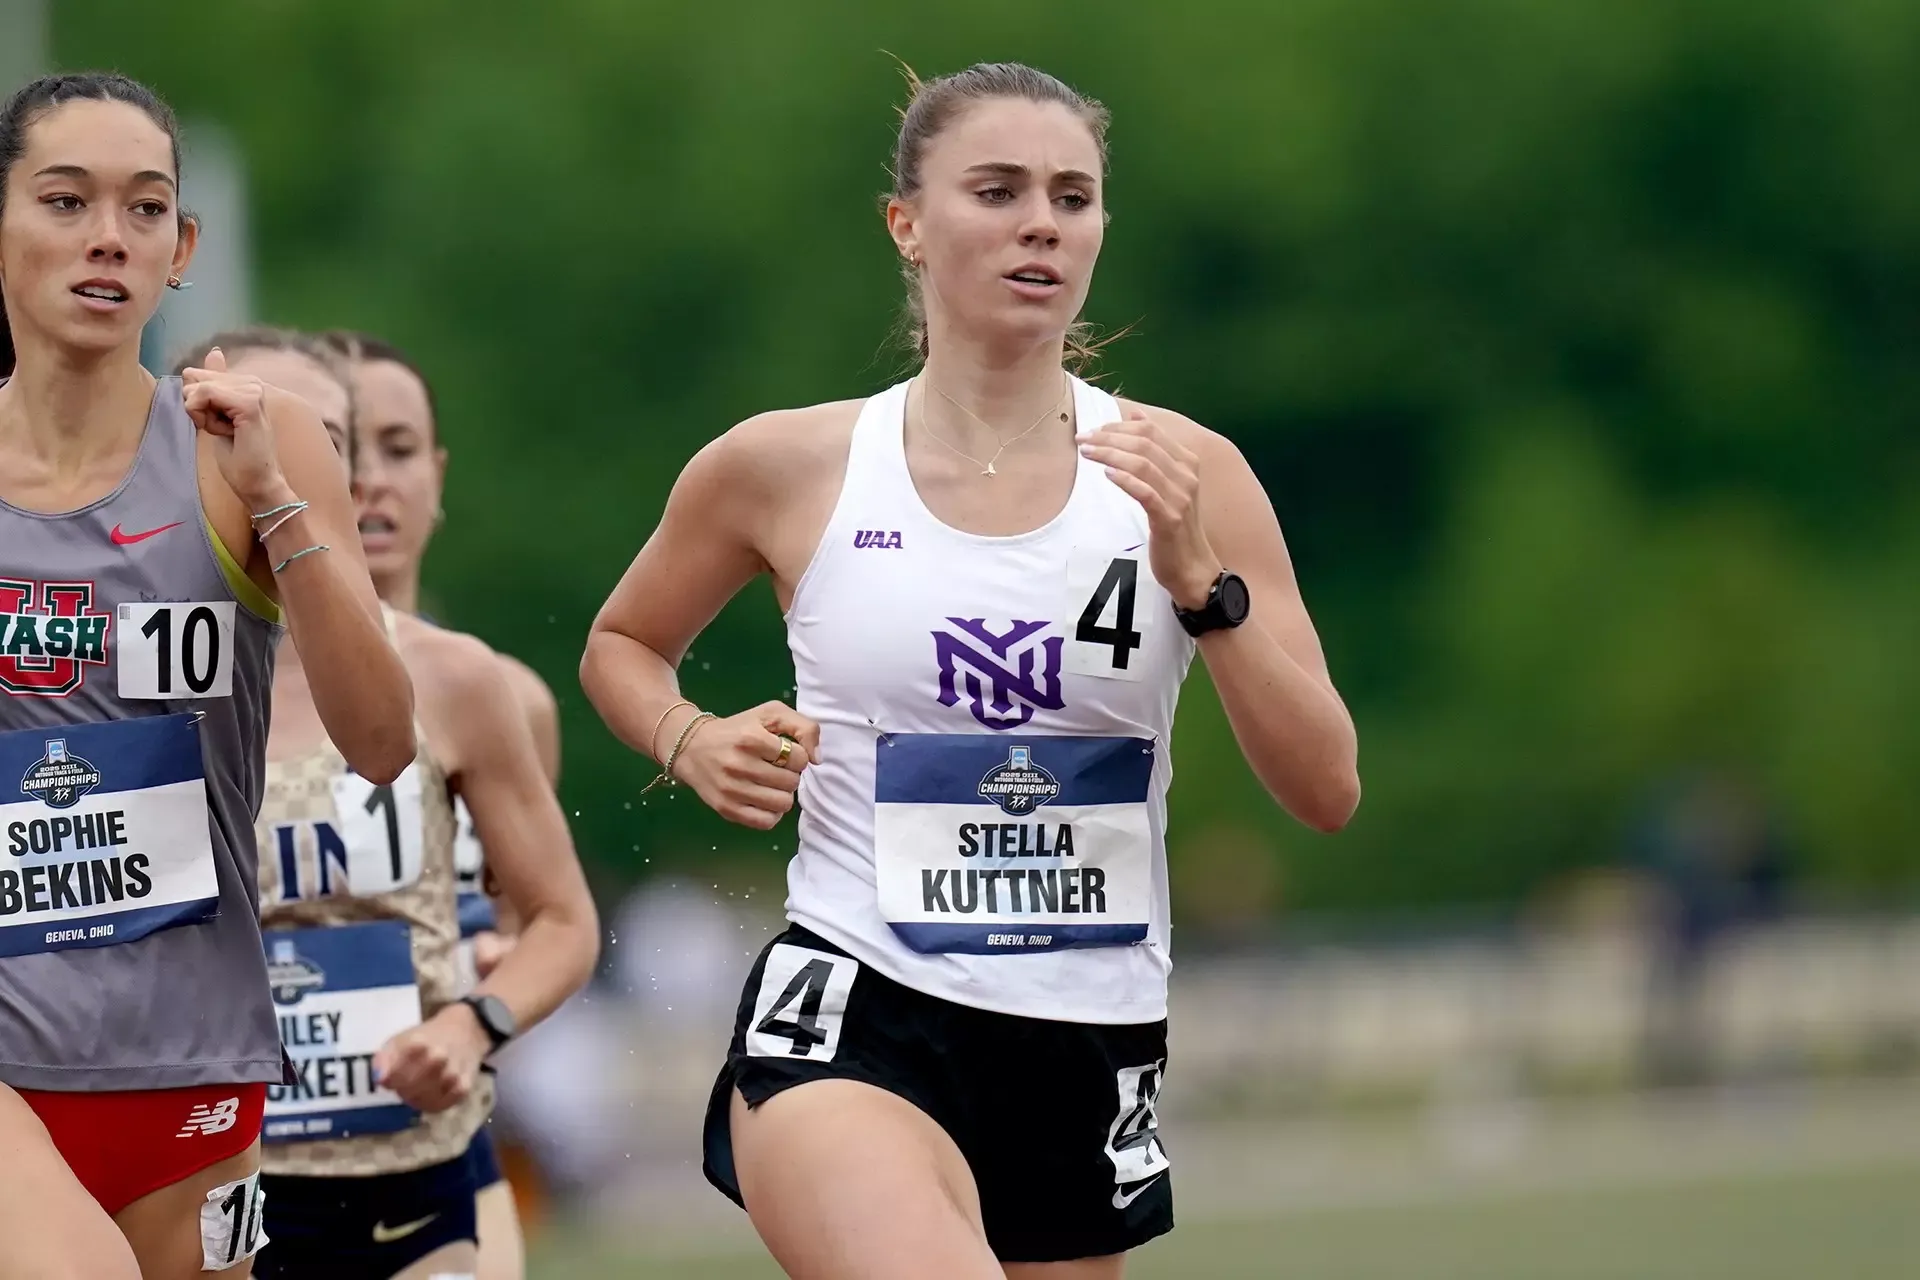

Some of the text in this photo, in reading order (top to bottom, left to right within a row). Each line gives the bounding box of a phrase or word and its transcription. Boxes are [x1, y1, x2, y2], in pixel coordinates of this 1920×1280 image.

[853, 530, 903, 549] UAA
[1075, 557, 1142, 670] 4
[140, 606, 220, 694] 10
[23, 773, 98, 790] CHAMPIONSHIPS
[980, 783, 1057, 794] CHAMPIONSHIPS
[8, 810, 128, 857] SOPHIE
[363, 784, 402, 882] 1
[958, 823, 1074, 858] STELLA
[0, 853, 152, 916] BEKINS
[921, 868, 1106, 914] KUTTNER
[45, 924, 114, 944] GENEVA, OHIO
[987, 933, 1052, 946] GENEVA, OHIO
[280, 1011, 341, 1047] ILEY
[755, 958, 835, 1056] 4
[1111, 1069, 1158, 1166] 4
